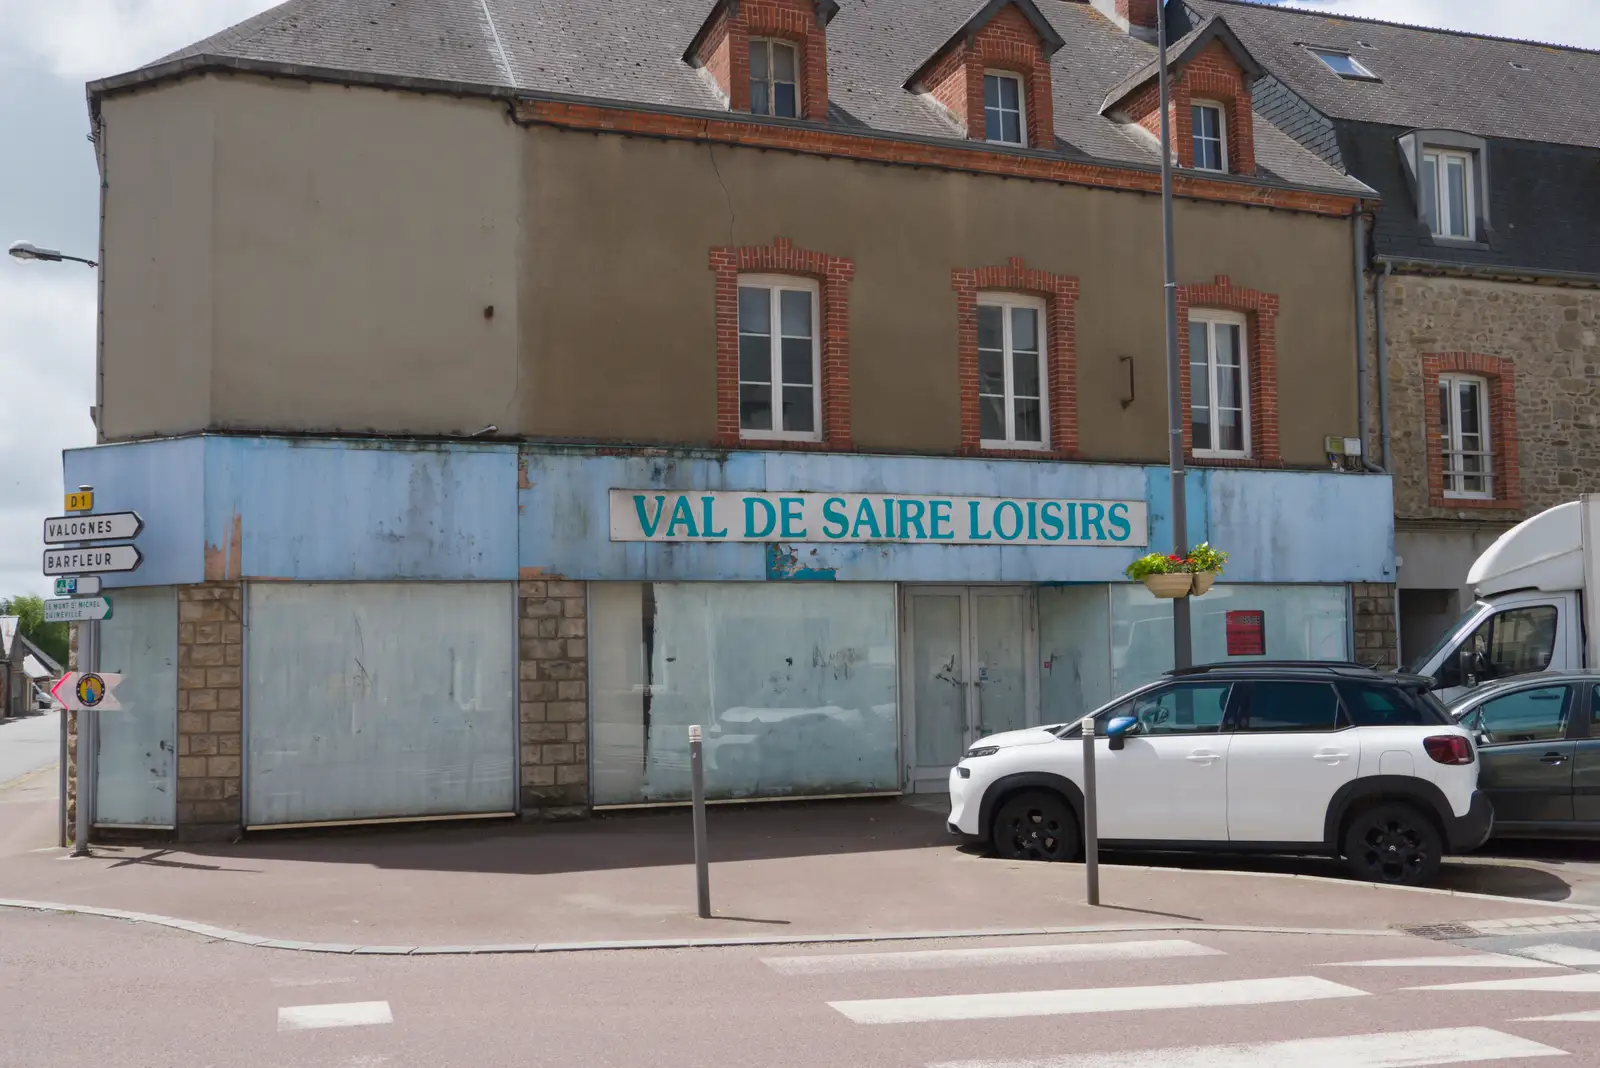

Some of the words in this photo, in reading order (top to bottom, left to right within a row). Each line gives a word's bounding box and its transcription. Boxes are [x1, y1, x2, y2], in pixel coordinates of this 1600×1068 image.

[633, 494, 728, 538] VAL
[744, 496, 806, 539] DE
[822, 497, 954, 541] SAIRE
[968, 500, 1132, 542] LOISIRS
[49, 520, 112, 537] VALOGNES
[48, 552, 112, 569] BARFLEUR
[53, 602, 69, 611] MONT
[78, 600, 101, 609] MICHEL
